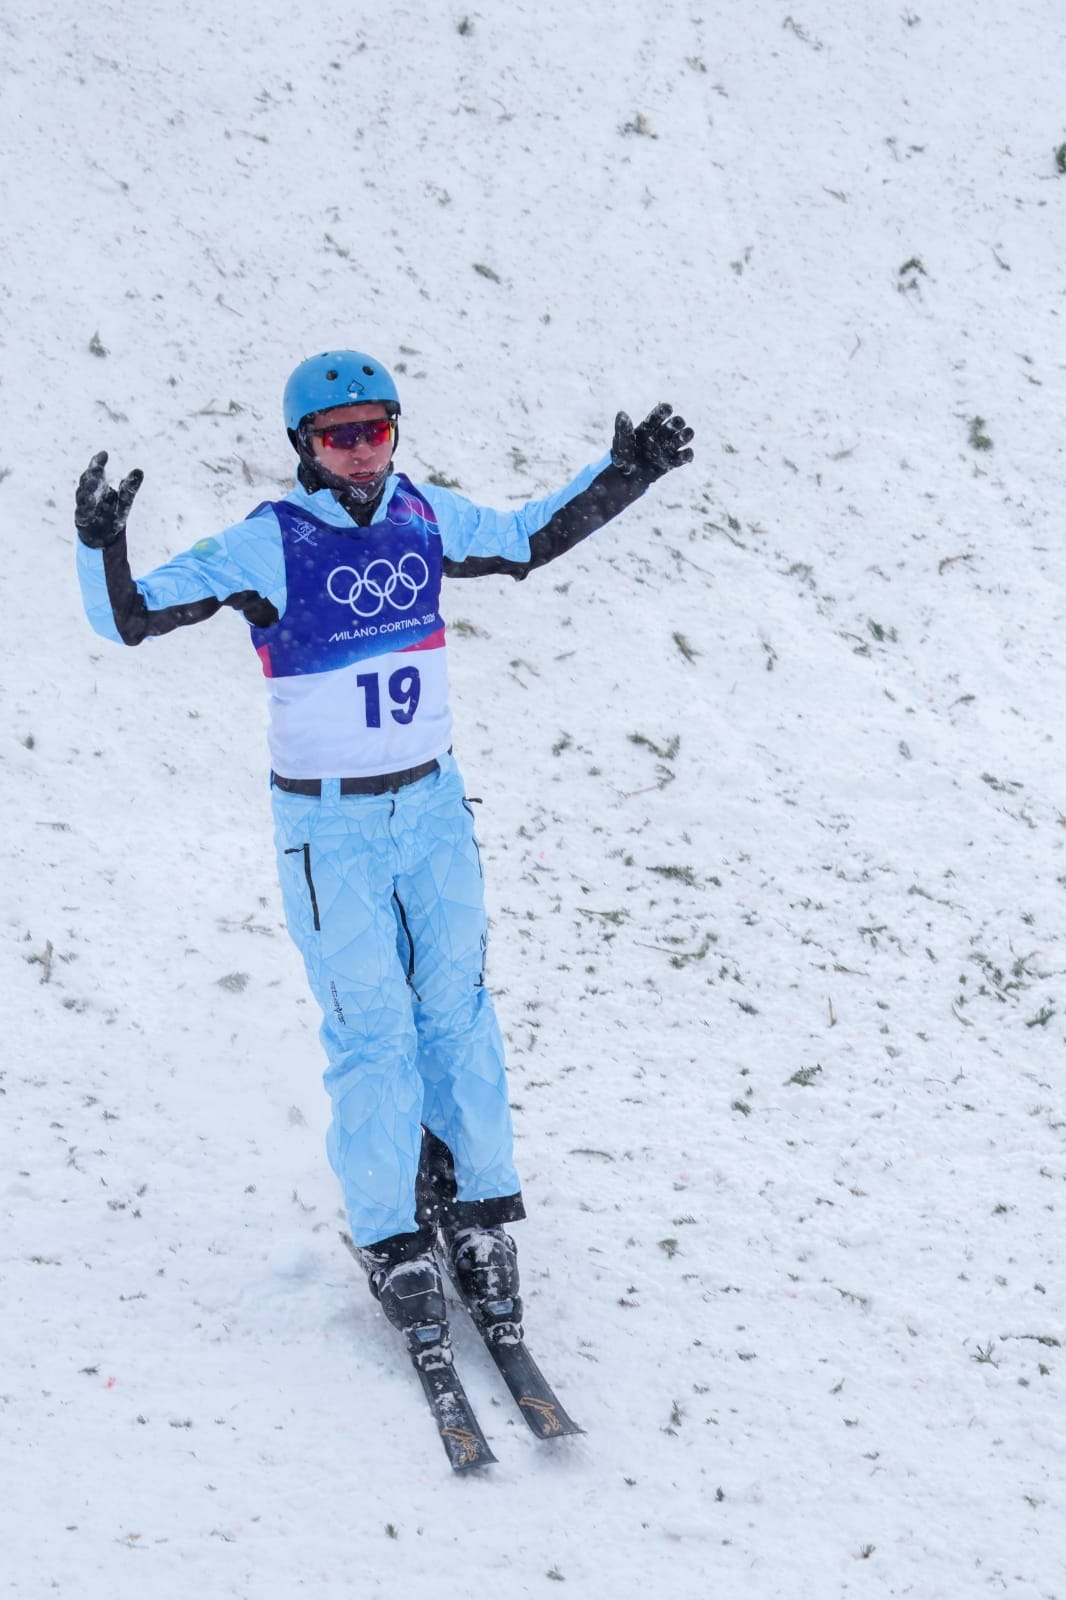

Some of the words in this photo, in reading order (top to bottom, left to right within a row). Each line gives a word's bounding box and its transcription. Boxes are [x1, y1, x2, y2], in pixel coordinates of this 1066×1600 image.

[328, 626, 377, 642] MILANO
[379, 618, 421, 634] CORTINA
[356, 665, 421, 728] 19
